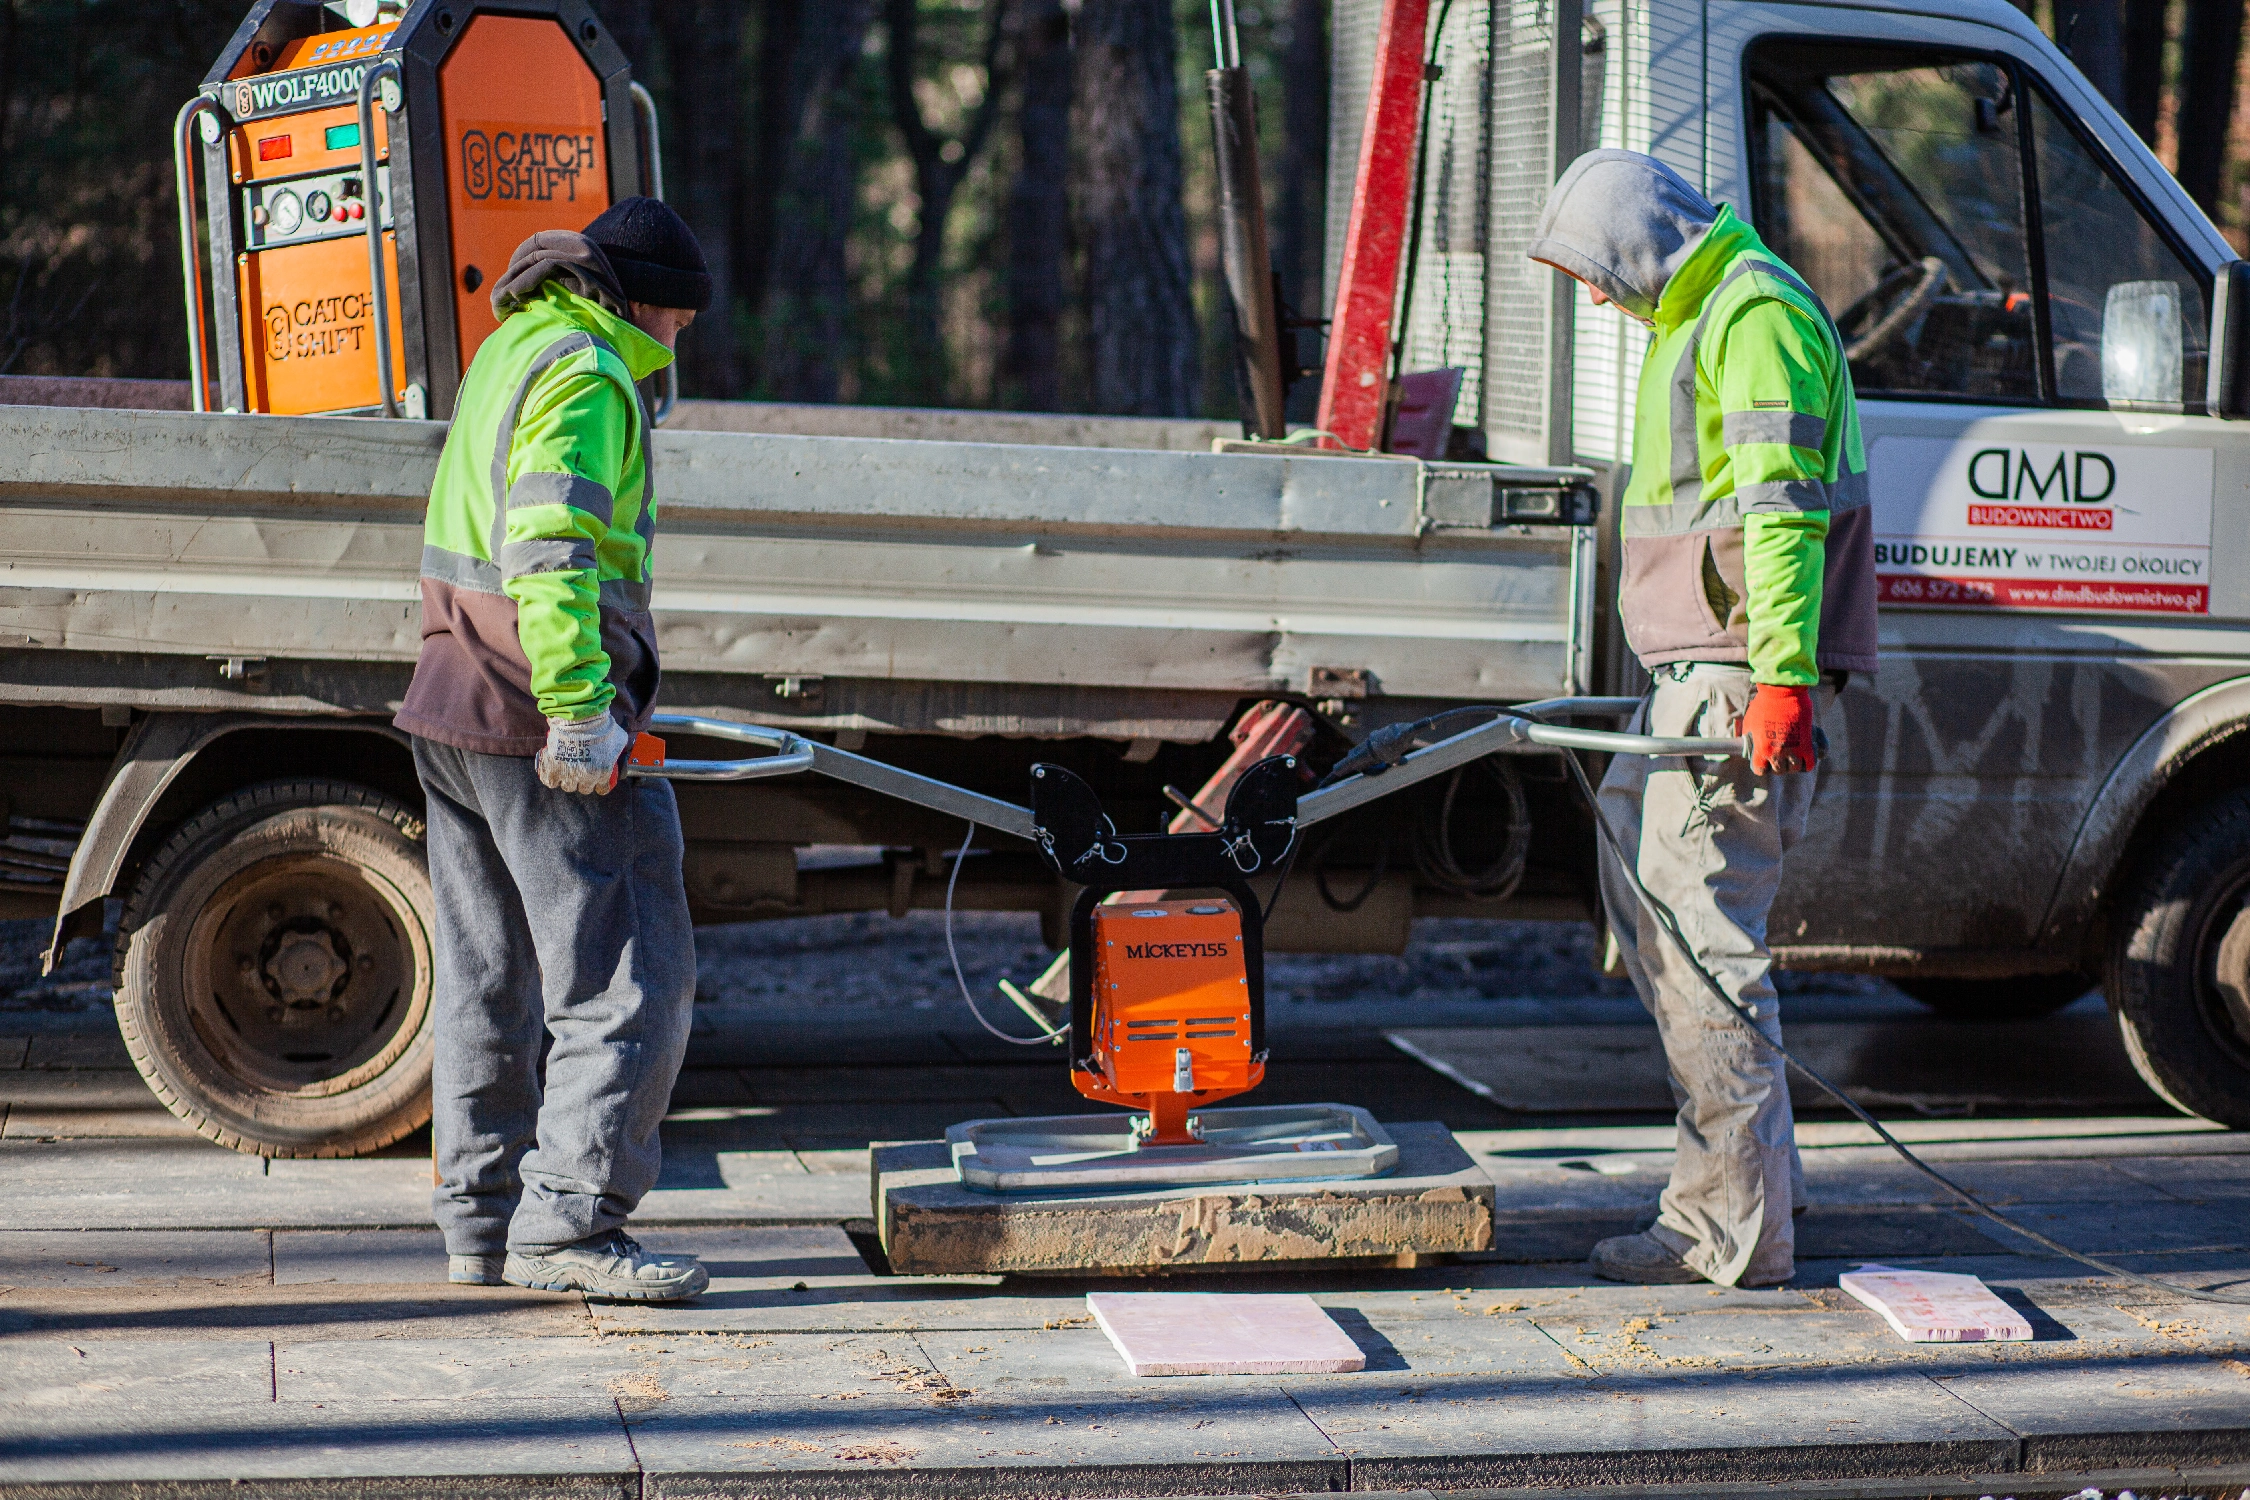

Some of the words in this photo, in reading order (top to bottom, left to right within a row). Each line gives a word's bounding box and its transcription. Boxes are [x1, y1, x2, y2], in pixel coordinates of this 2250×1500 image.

[252, 65, 367, 110] WOLF4000
[494, 131, 594, 169] CATCH
[497, 165, 580, 202] SHIFT
[294, 292, 374, 326] CATCH
[296, 325, 365, 358] SHIFT
[1967, 448, 2117, 503] DMD
[1970, 506, 2111, 529] BUDOWNICTWO
[1874, 543, 2018, 568] BUDUJEMY
[2049, 553, 2117, 574] TWOJEJ
[2122, 555, 2203, 576] OKOLICY
[1890, 578, 1924, 598] 606
[2008, 585, 2202, 612] www.dmdbudownictwo.pl
